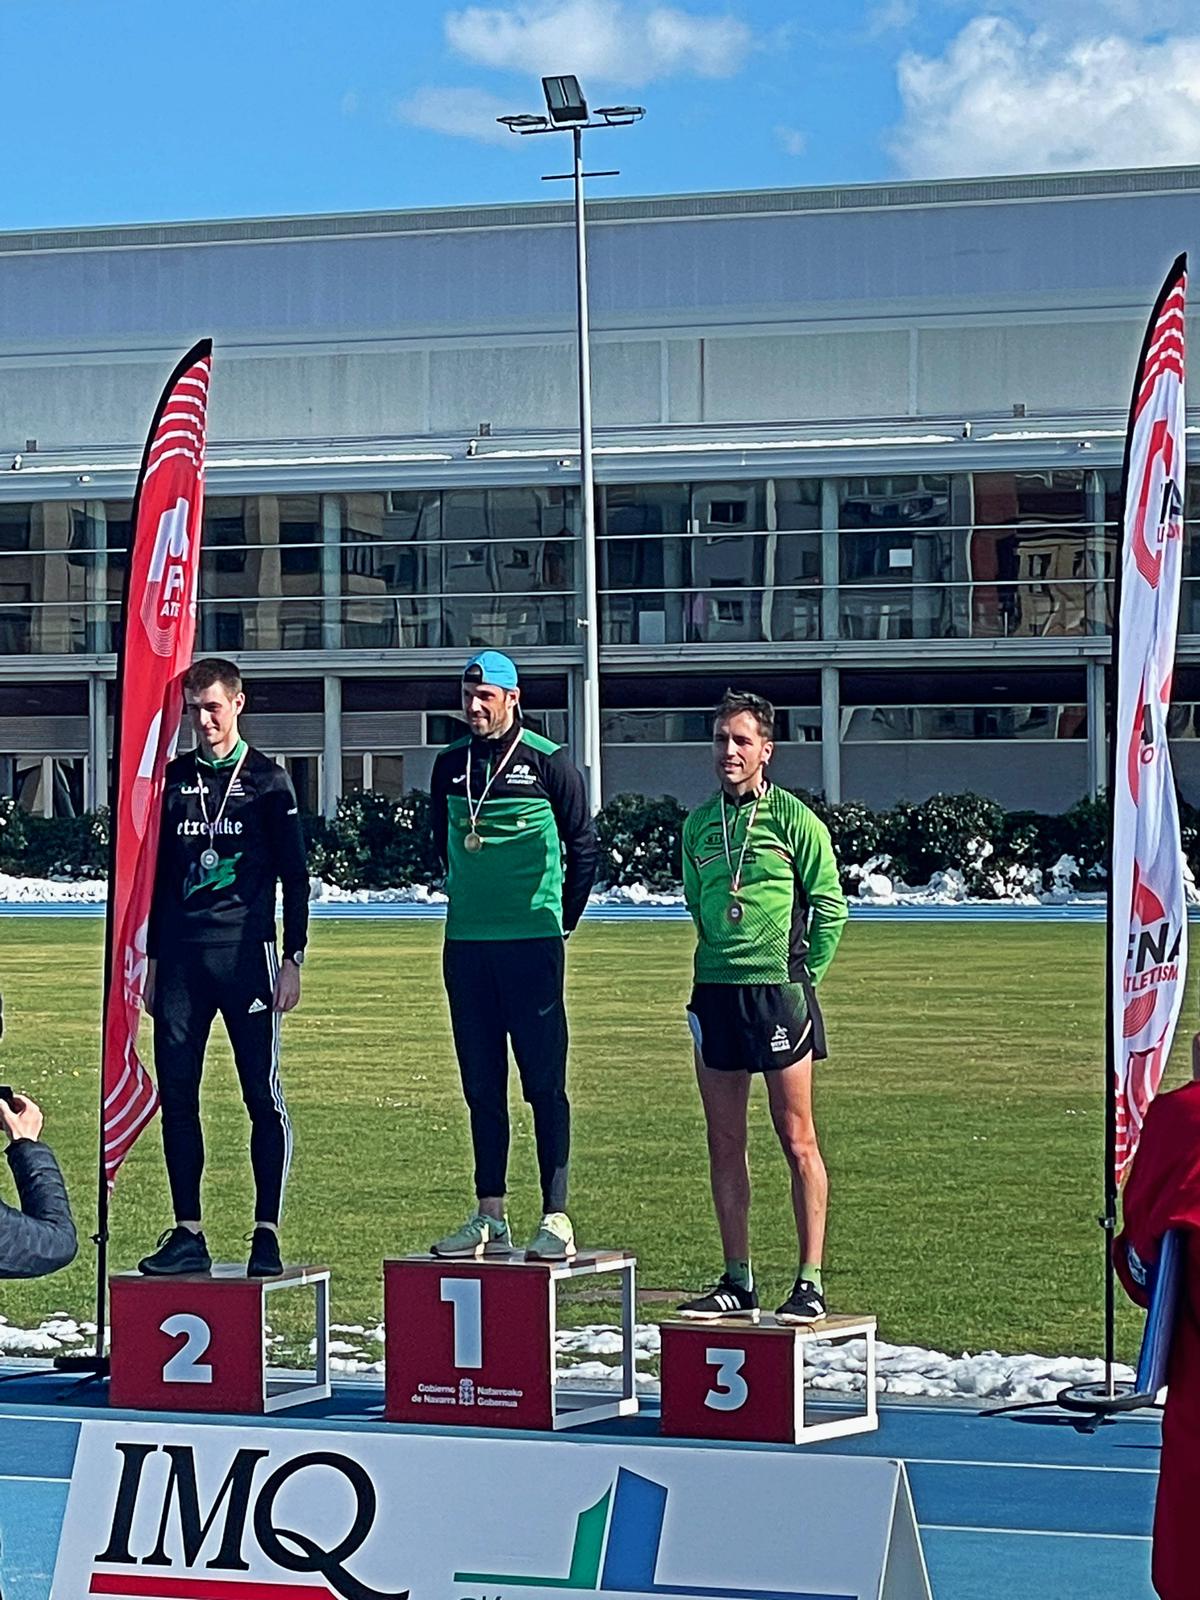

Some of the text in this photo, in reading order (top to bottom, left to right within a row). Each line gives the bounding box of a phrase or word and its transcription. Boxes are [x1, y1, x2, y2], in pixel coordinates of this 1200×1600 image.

[159, 1313, 213, 1384] 2
[440, 1277, 482, 1369] 1
[418, 1383, 456, 1394] Gobierno
[424, 1394, 456, 1404] Navarra
[703, 1347, 749, 1411] 3
[94, 1442, 410, 1600] IMQ
